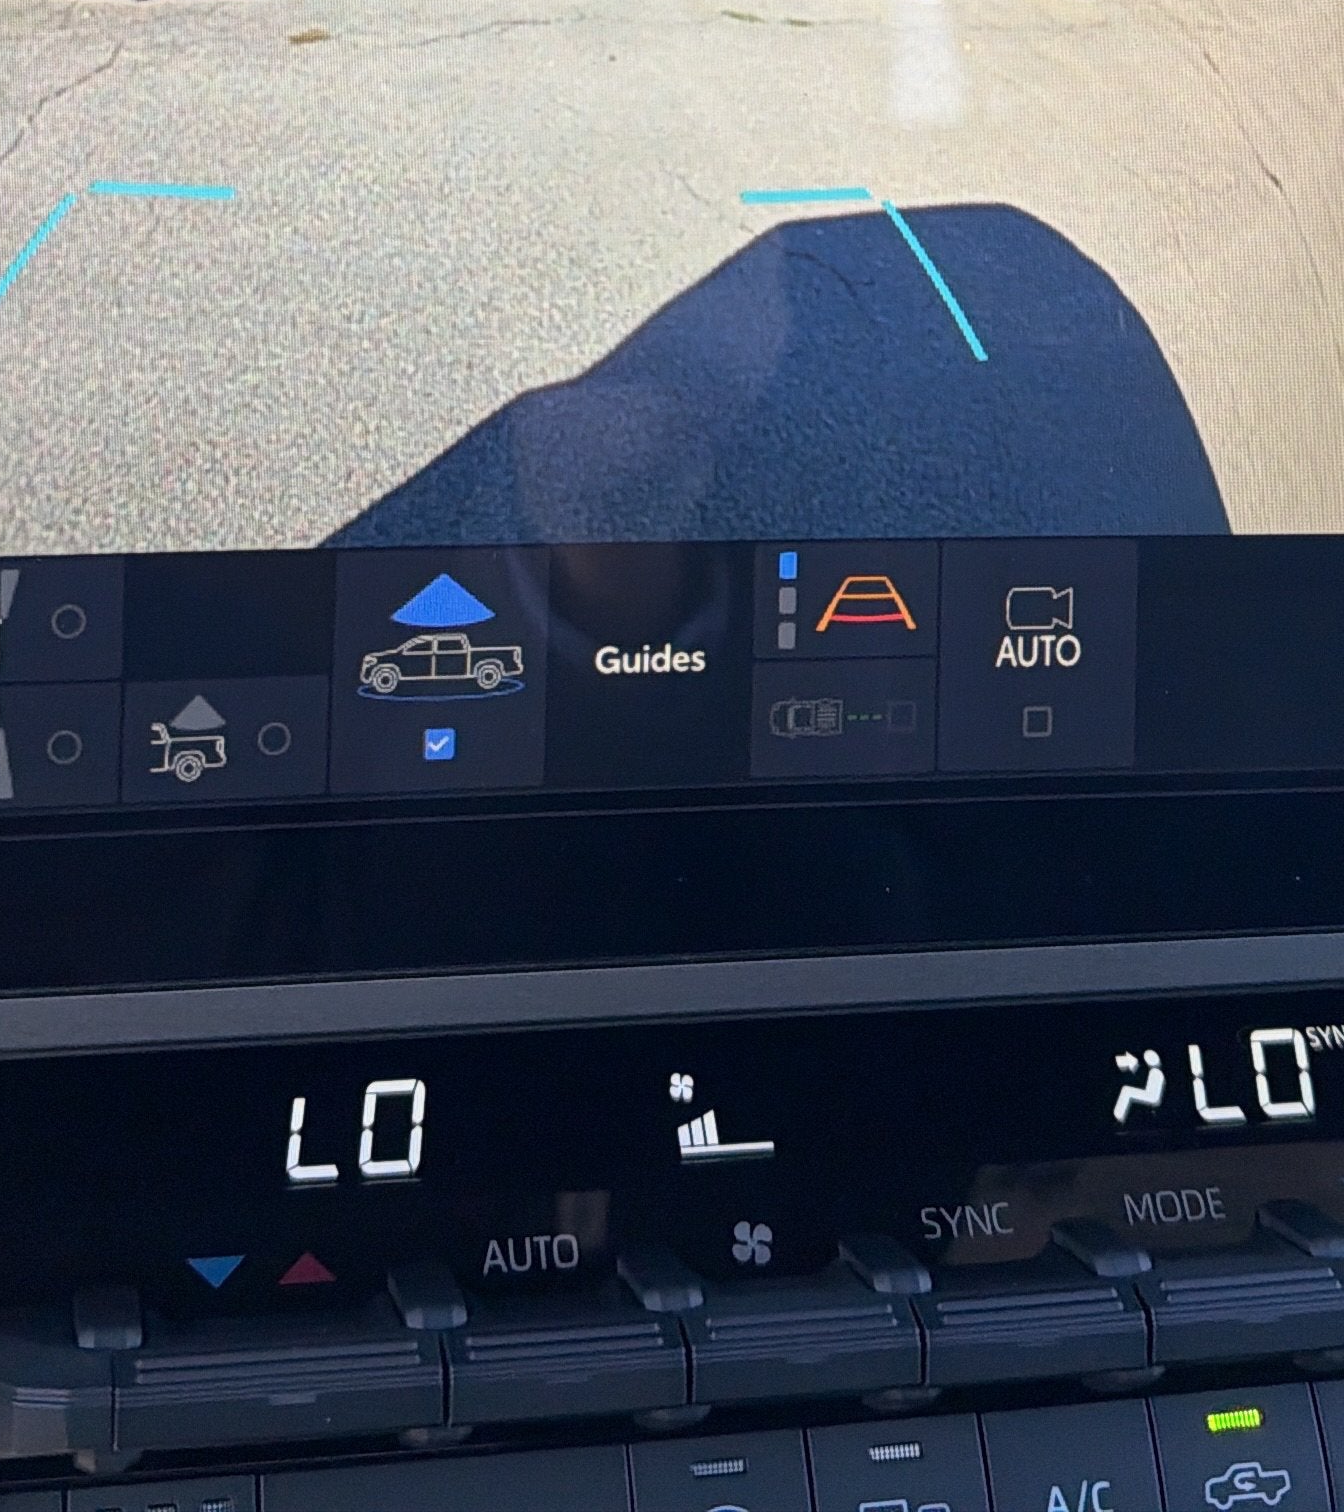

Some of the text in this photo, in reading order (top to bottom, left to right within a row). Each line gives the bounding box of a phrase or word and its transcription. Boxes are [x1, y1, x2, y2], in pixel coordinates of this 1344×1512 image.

[594, 643, 707, 675] Guides
[995, 634, 1083, 669] AUTO
[1188, 1027, 1316, 1124] LO
[286, 1078, 426, 1182] LO
[920, 1201, 1015, 1240] SYNC
[1123, 1187, 1227, 1226] MODE
[482, 1233, 580, 1276] AUTO
[1047, 1479, 1114, 1512] A/C
